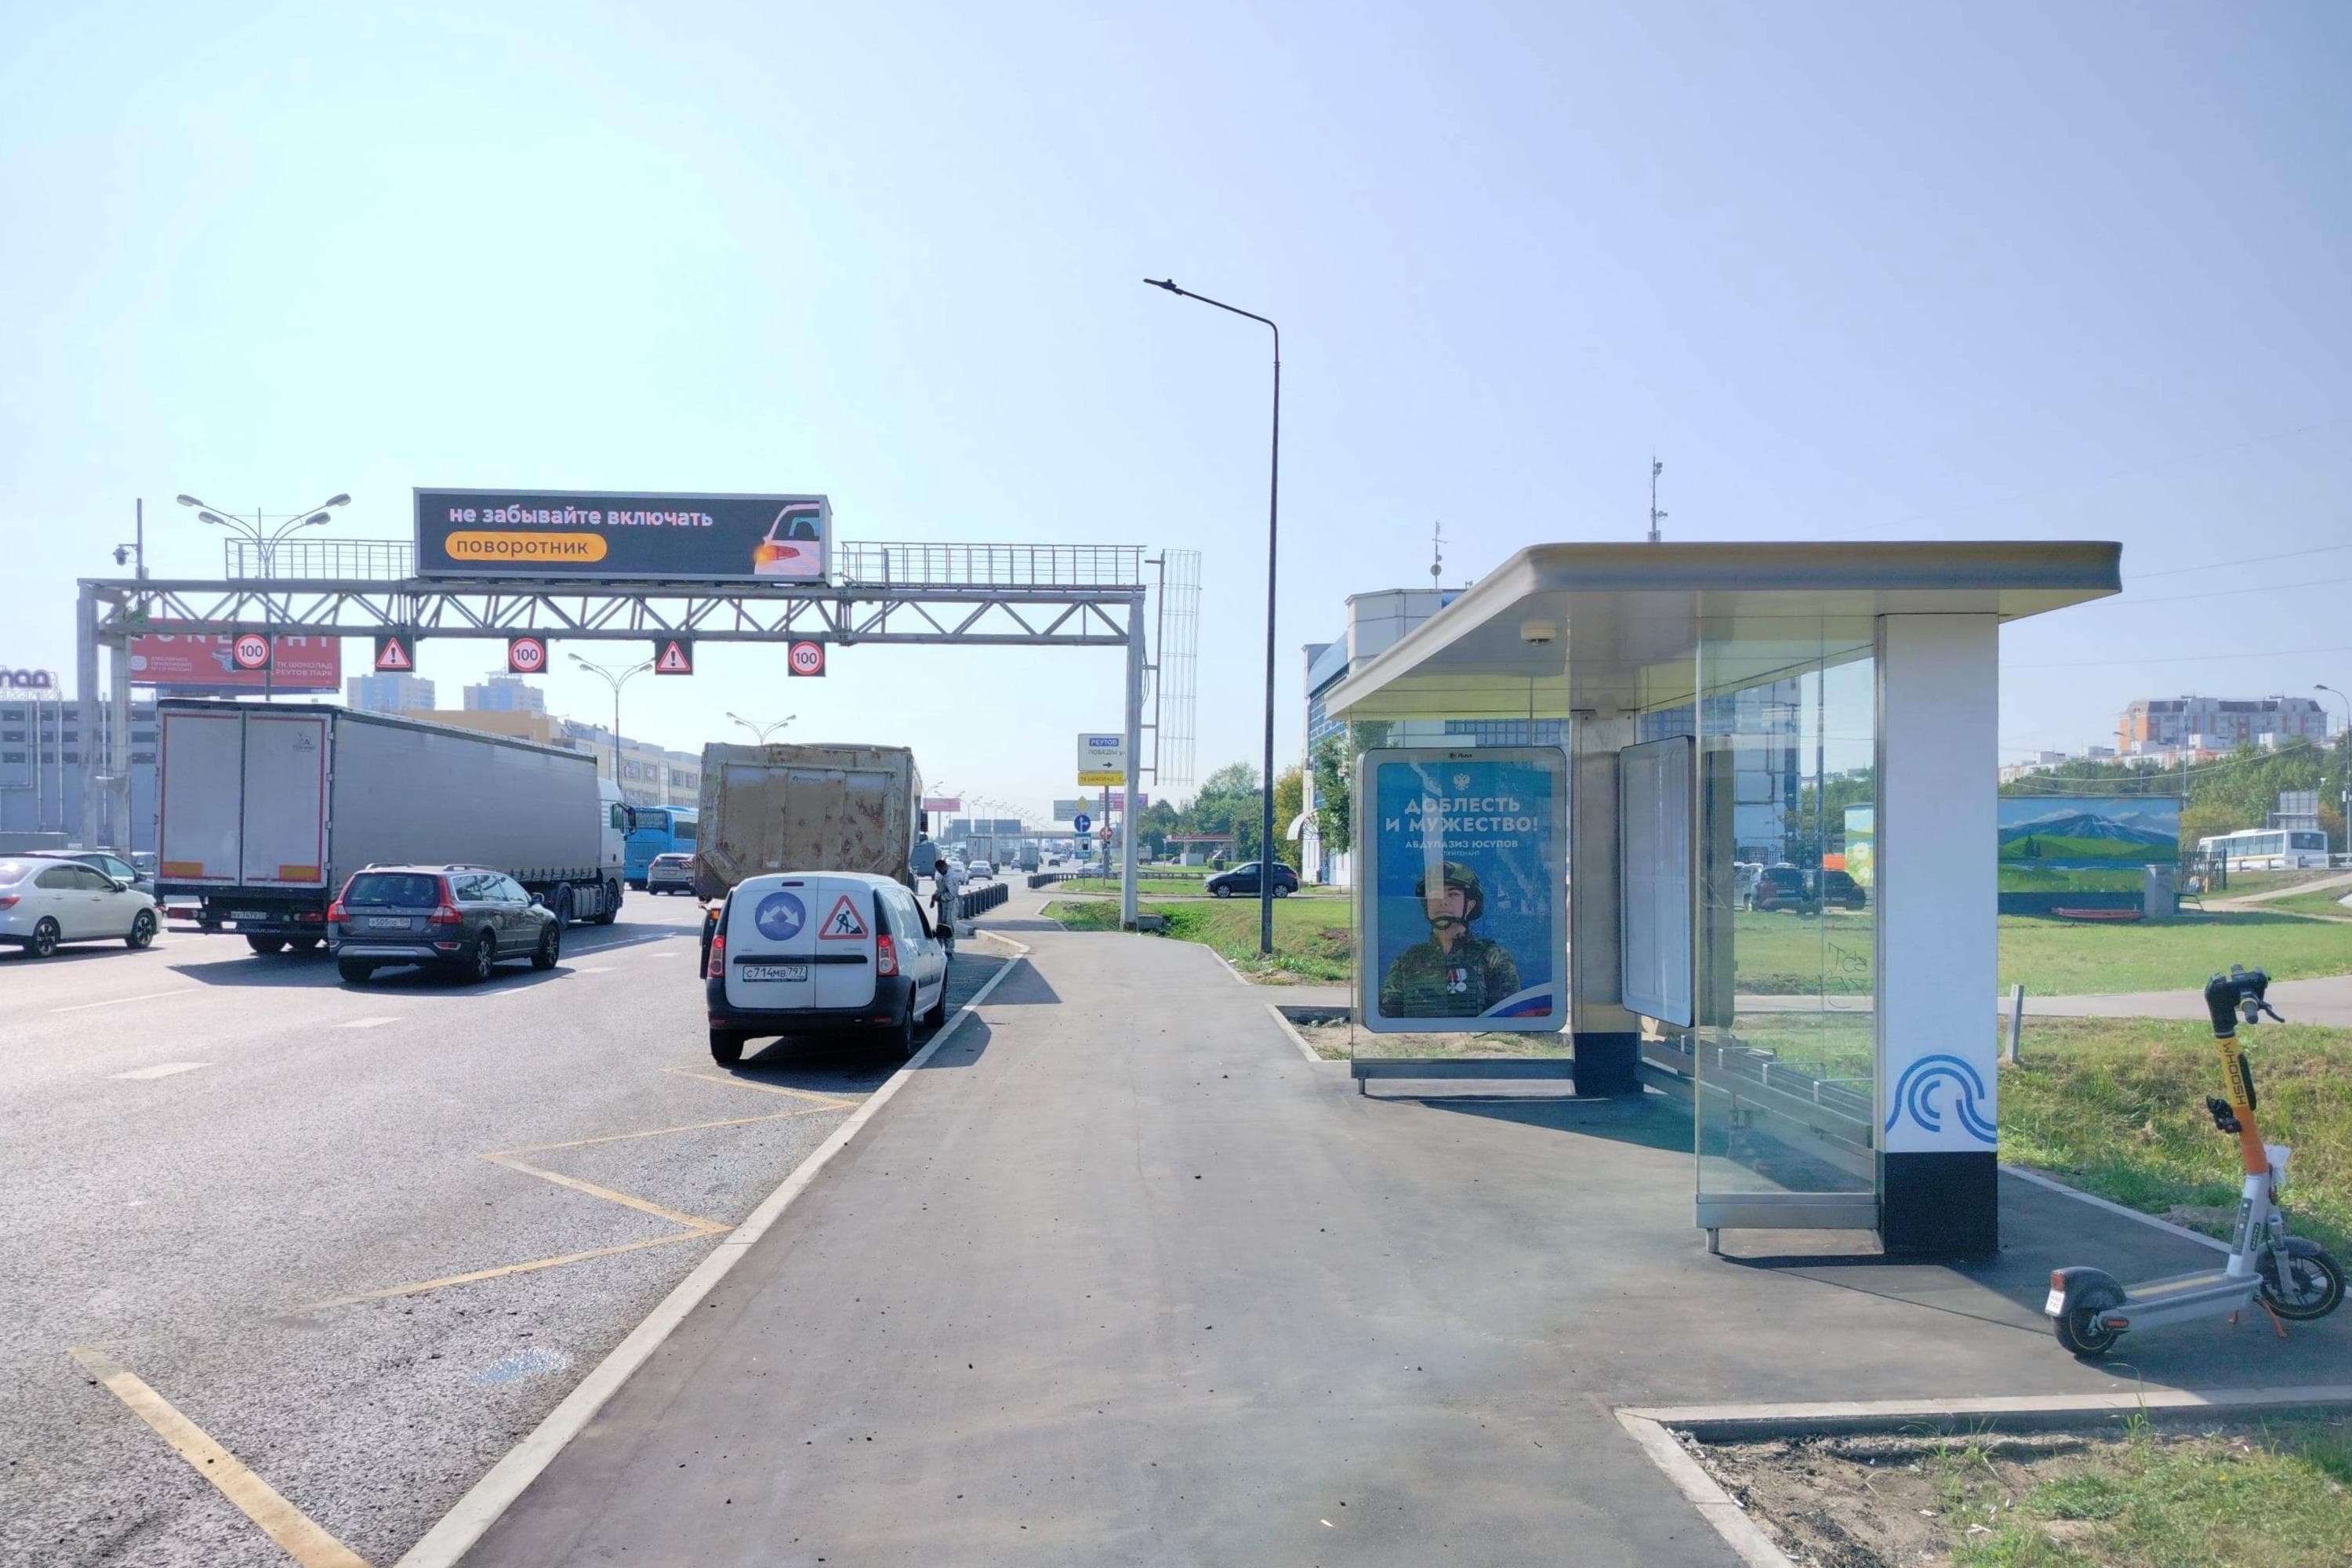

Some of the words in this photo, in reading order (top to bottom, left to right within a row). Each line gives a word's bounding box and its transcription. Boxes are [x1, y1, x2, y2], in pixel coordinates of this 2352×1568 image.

[449, 508, 477, 523] не
[482, 503, 602, 525] забывайте
[608, 510, 713, 527] включать
[456, 540, 589, 557] поворотник
[240, 644, 263, 658] 100
[516, 648, 539, 661] 100
[795, 652, 818, 664] 100
[1404, 797, 1521, 815] ДОБЛЕСТЬ
[1385, 817, 1399, 833] И
[1409, 817, 1538, 833] МУЖЕСТВО!
[1472, 840, 1519, 848] ЮСУПОВ
[2223, 1042, 2246, 1105] WHOOSH
